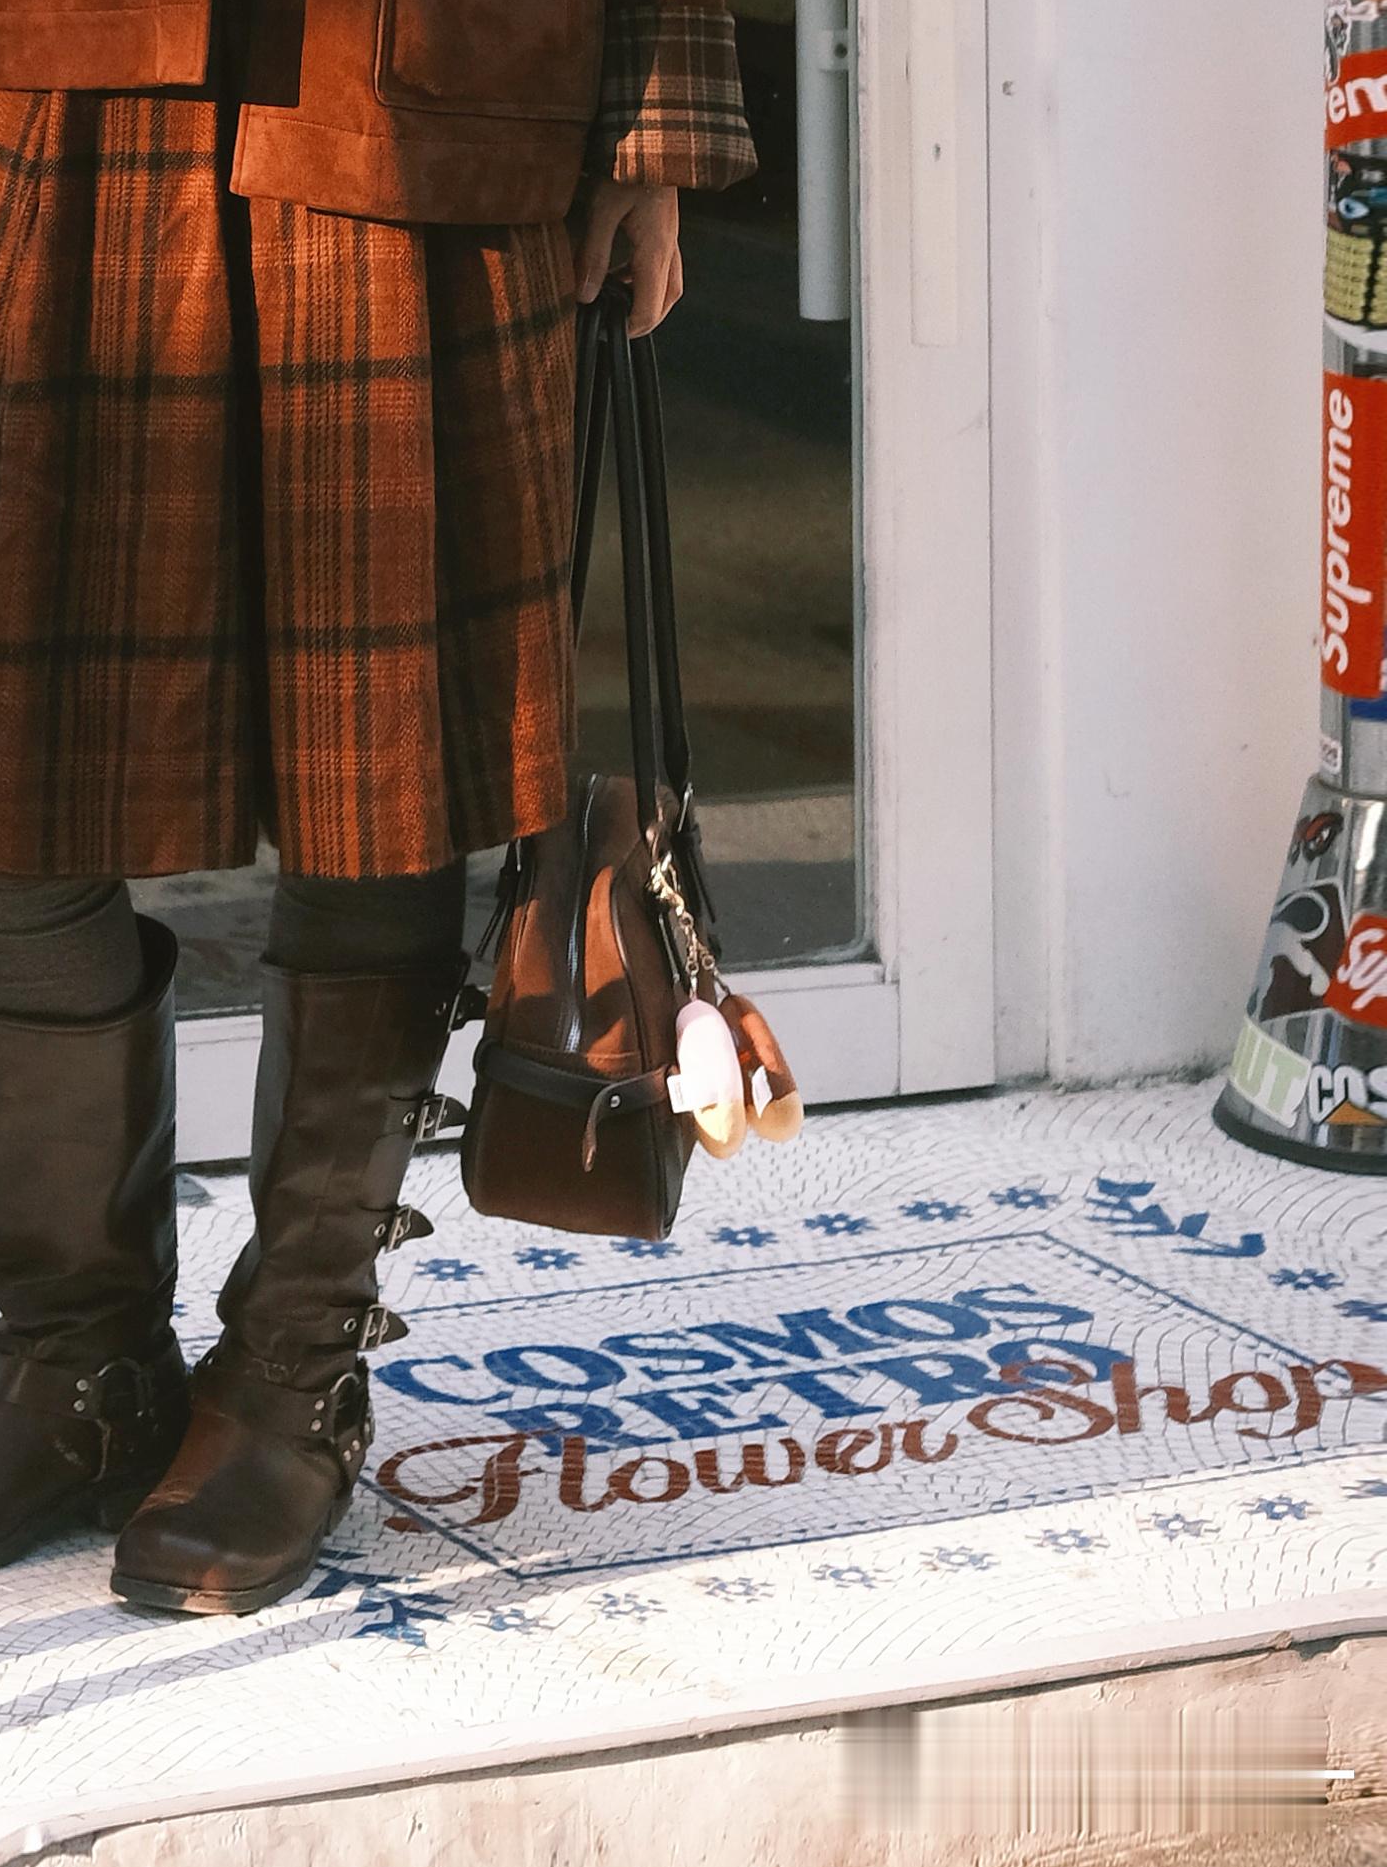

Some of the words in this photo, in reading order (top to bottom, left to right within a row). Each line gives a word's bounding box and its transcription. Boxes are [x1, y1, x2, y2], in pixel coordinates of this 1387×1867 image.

[1321, 387, 1374, 677] Supreme
[370, 1282, 1095, 1405] COSMOS
[488, 1338, 1133, 1454] RETRO
[376, 1418, 960, 1532] Flower
[968, 1356, 1387, 1443] Shop
